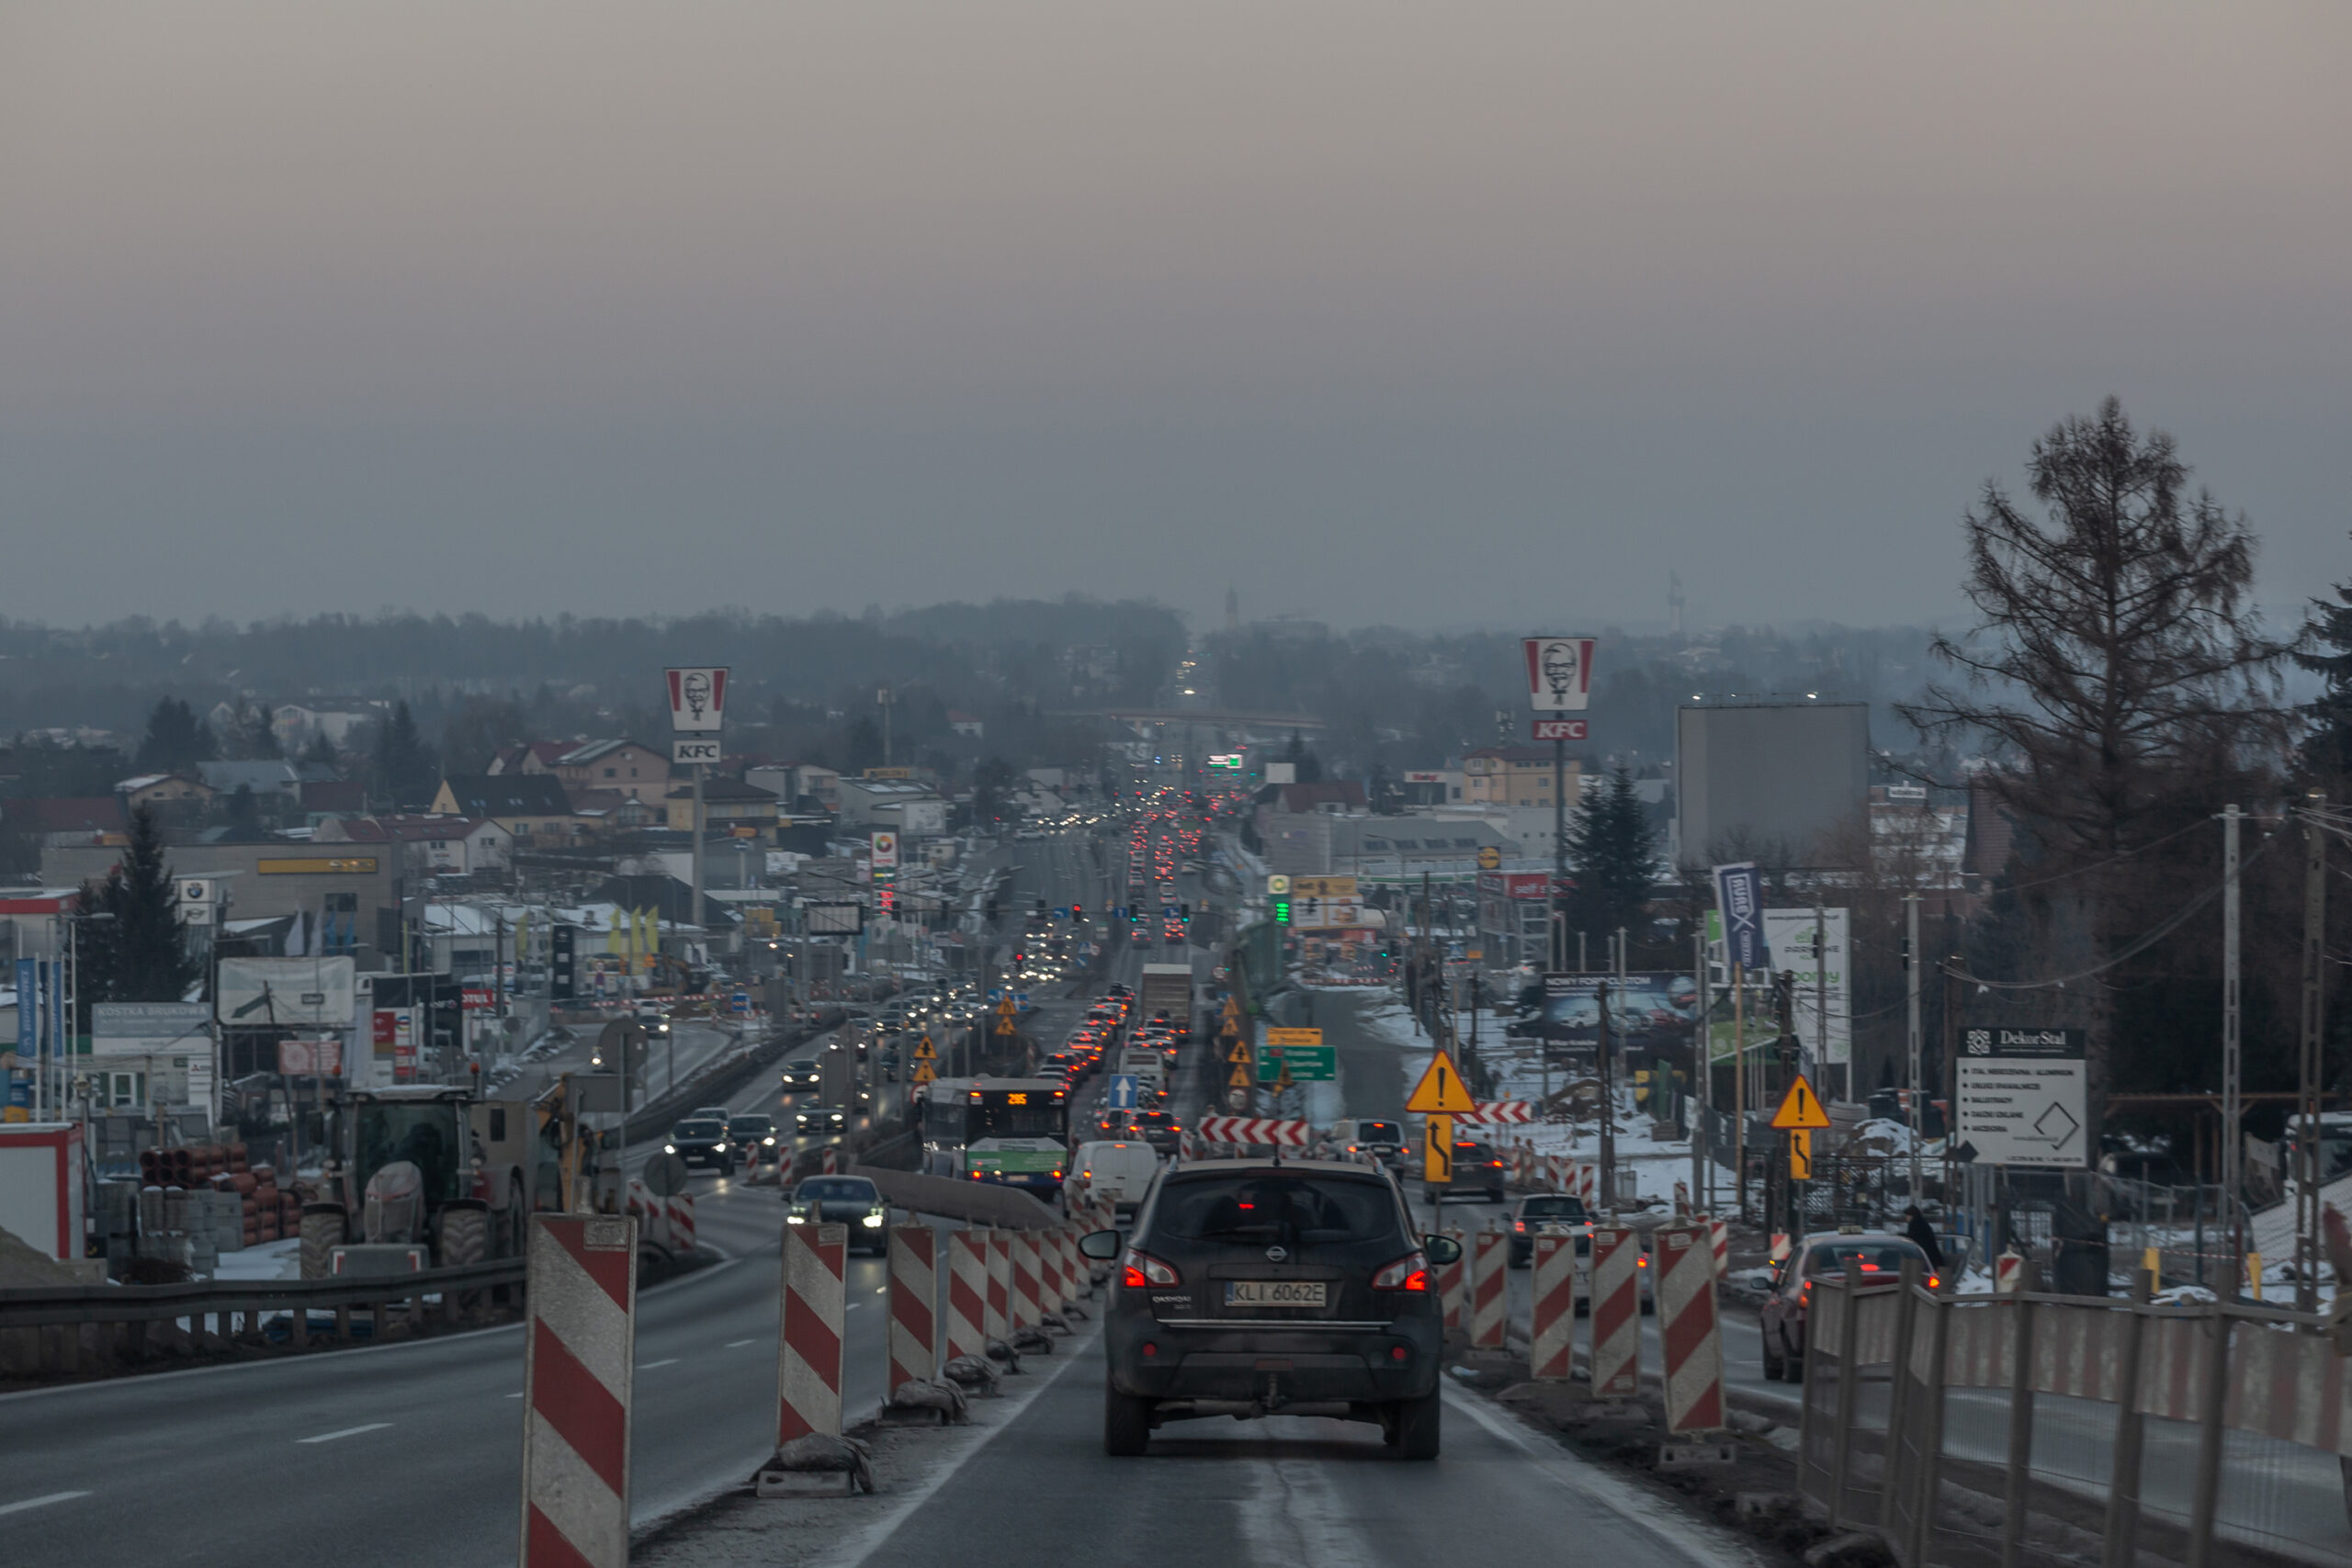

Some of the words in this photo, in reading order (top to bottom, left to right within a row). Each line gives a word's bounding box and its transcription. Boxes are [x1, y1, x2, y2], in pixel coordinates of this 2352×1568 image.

[1536, 722, 1584, 738] KFC
[678, 745, 717, 759] KFC
[1545, 977, 1576, 986] NOWY
[97, 1007, 144, 1016] KOSTKA
[1235, 1282, 1264, 1303] KLI
[1272, 1282, 1324, 1303] 6062E
